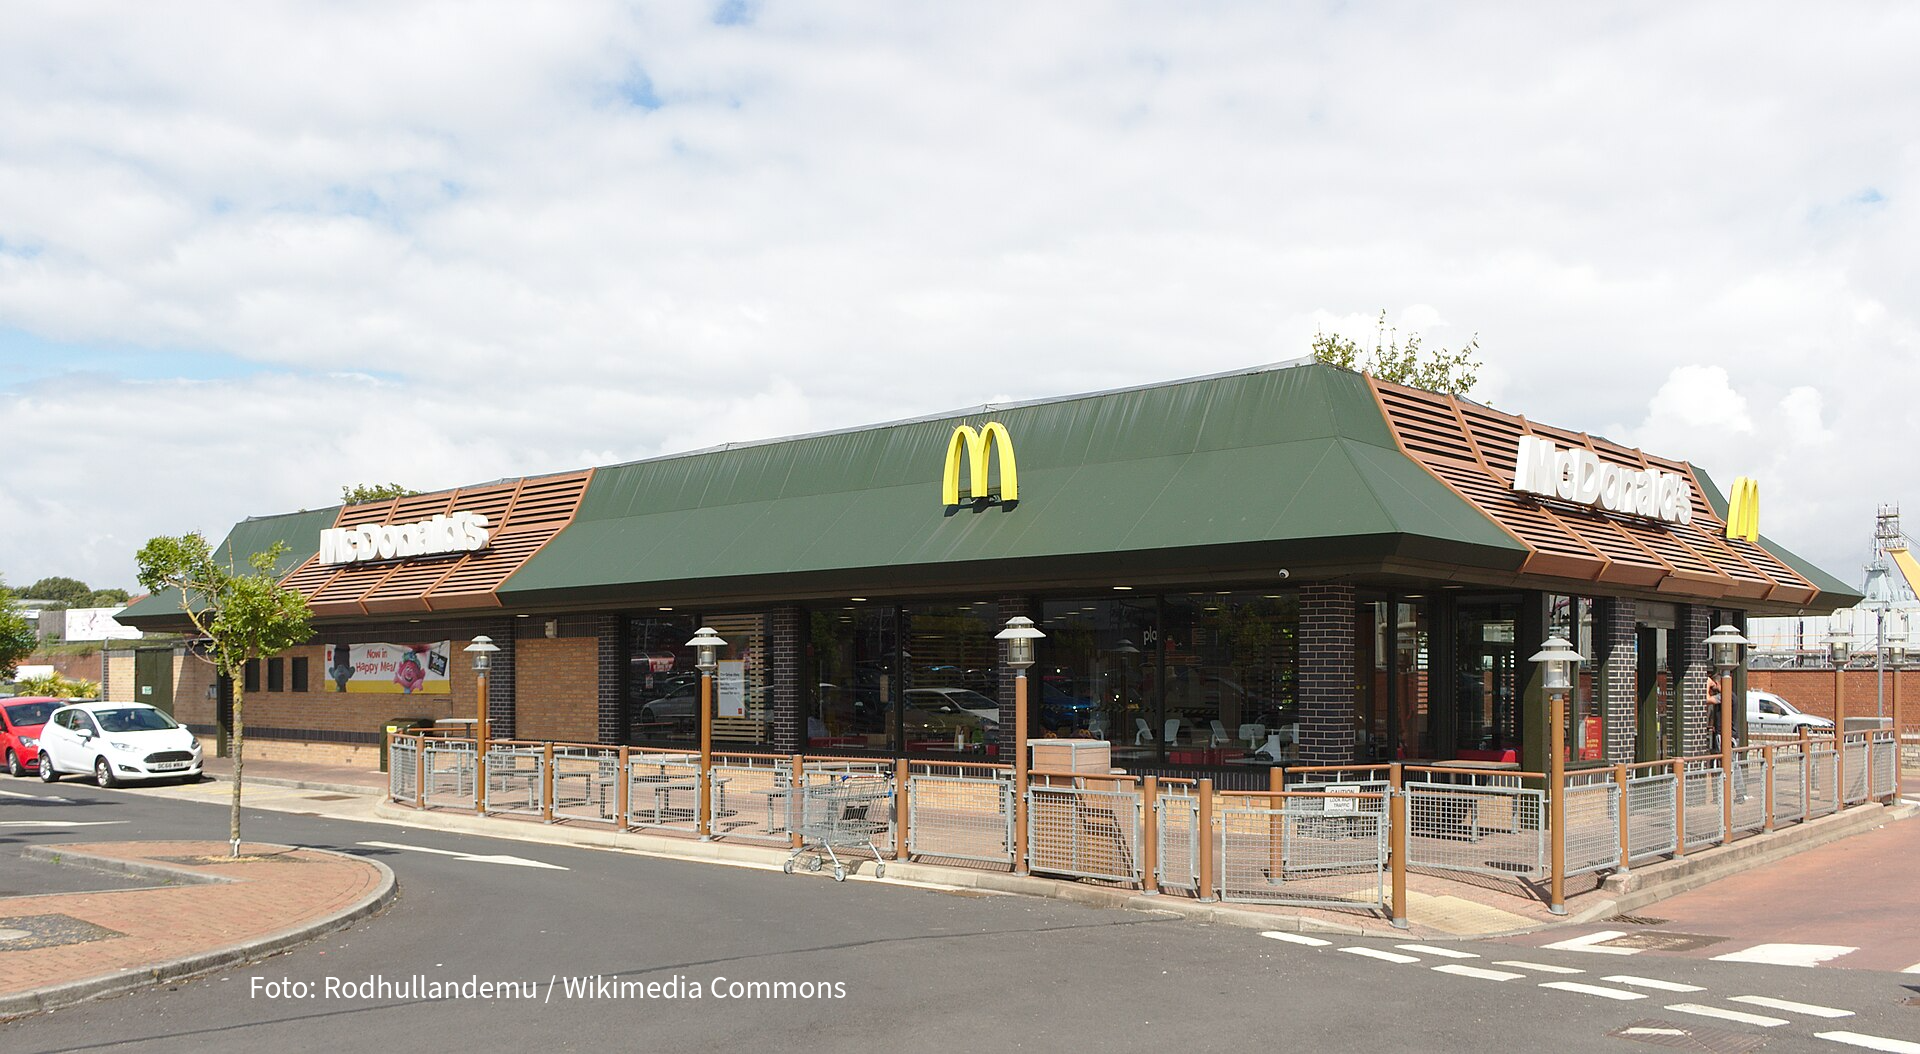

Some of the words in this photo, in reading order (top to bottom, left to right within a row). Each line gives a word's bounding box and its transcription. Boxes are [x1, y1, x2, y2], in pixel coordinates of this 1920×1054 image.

[1513, 434, 1693, 526] McDonald's
[319, 510, 490, 565] McDonald's
[355, 661, 379, 674] Happy
[366, 648, 380, 659] Now
[381, 647, 388, 659] in
